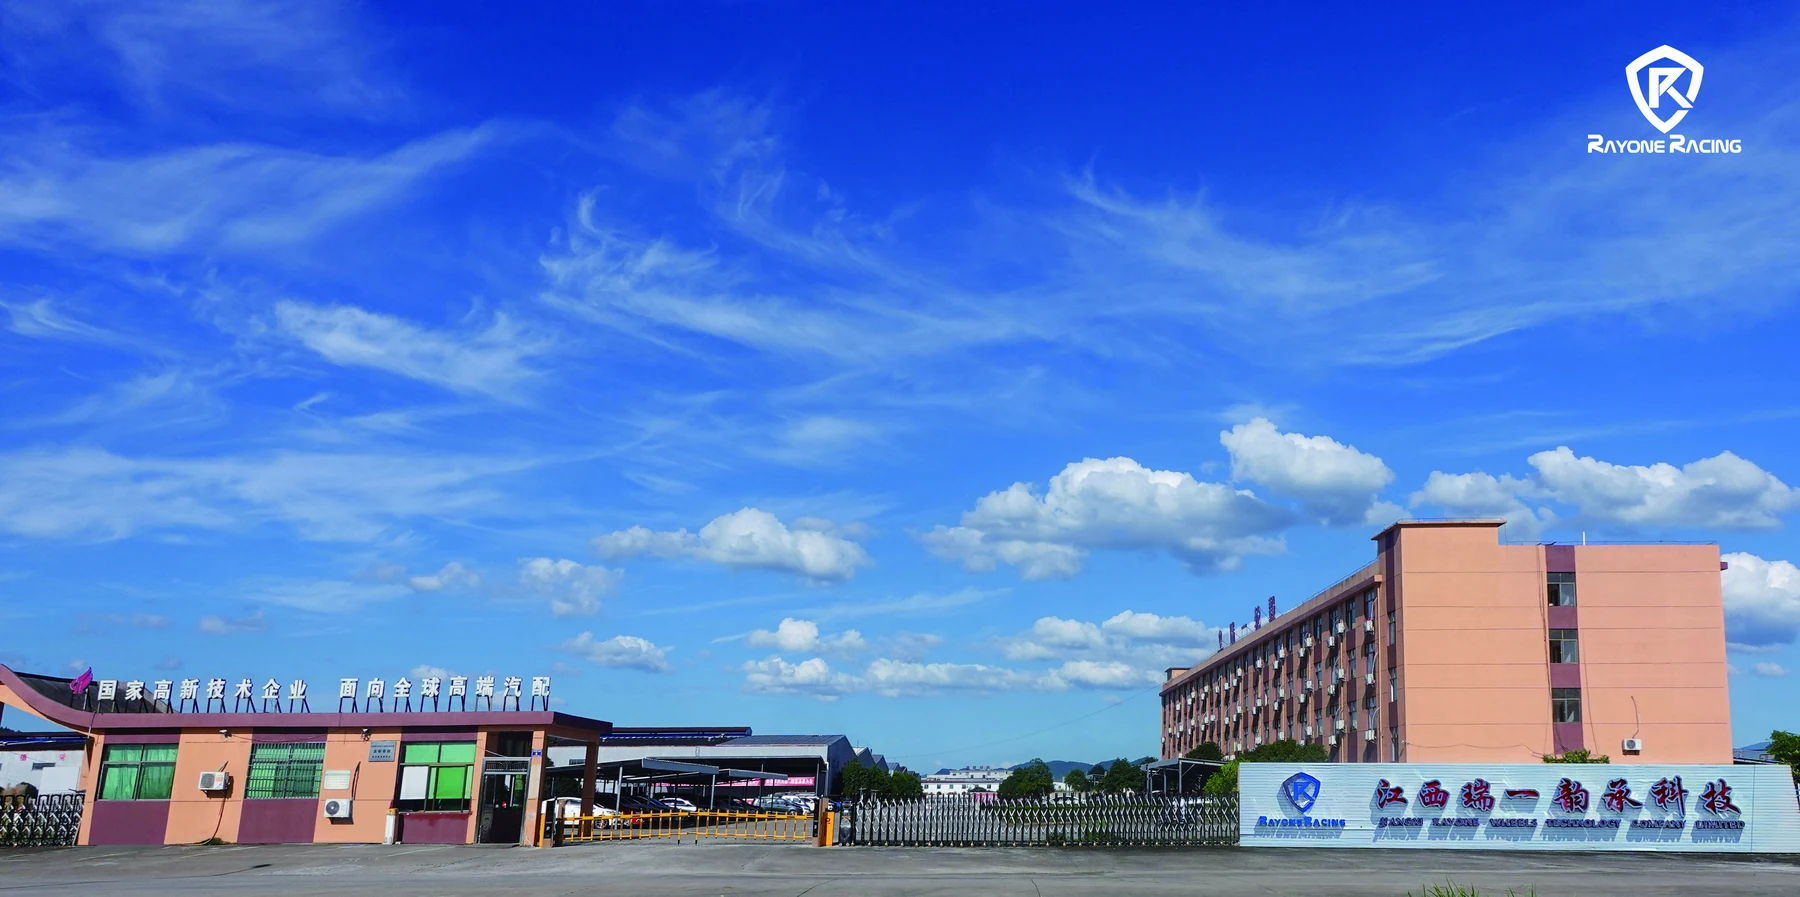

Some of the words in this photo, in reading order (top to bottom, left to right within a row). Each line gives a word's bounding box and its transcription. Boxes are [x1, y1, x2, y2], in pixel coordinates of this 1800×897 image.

[97, 678, 308, 701] 国家高新技术企业
[339, 675, 551, 699] 面向全球高端汽配
[1376, 775, 1743, 818] 江西瑞一韵承科技
[1259, 816, 1303, 827] RAYONE
[1304, 816, 1346, 827] RACING
[1432, 817, 1479, 827] RAYONE
[1489, 818, 1538, 828] WHEELS
[1546, 819, 1621, 829] TECHNOLOGY
[1631, 819, 1686, 829] COMPANY
[1695, 820, 1746, 830] LIMITED
